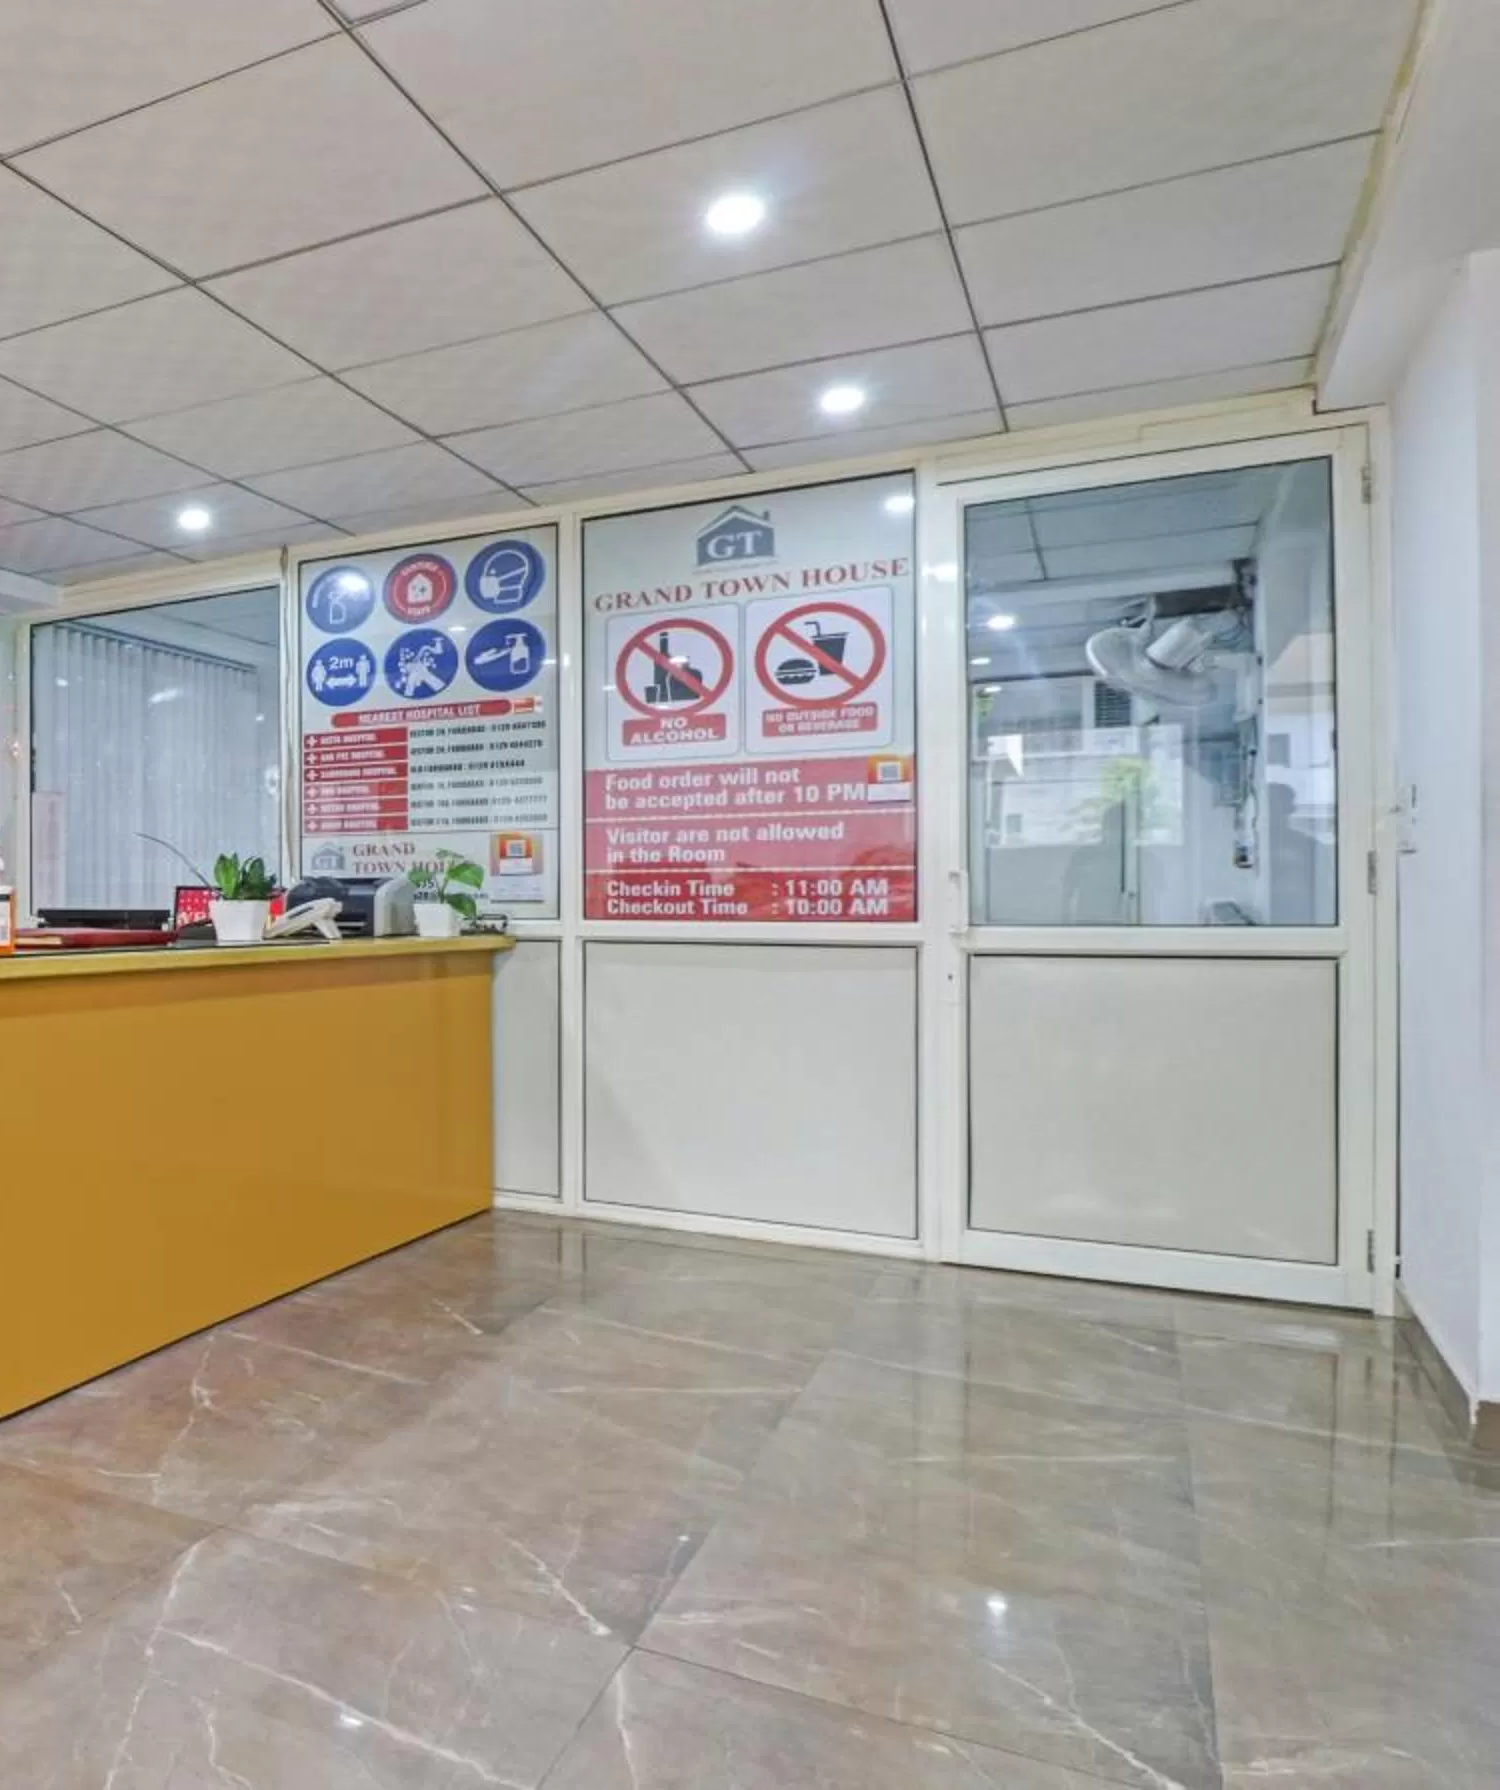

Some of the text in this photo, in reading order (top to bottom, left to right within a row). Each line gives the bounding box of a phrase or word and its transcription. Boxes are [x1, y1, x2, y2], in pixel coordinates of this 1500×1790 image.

[706, 530, 764, 560] GT
[594, 556, 911, 613] GRAND TOWN HOUSE
[329, 656, 355, 669] 2m
[840, 706, 875, 719] FOOD
[660, 716, 689, 729] NO
[630, 728, 720, 745] ALCOHOL
[605, 767, 800, 791] Food order will not
[605, 783, 868, 812] be accepted after 10 PM
[606, 821, 846, 845] Visitor are not allowed
[352, 842, 417, 857] GRAND
[606, 845, 726, 864] in the Room
[352, 861, 406, 875] TOWN
[606, 879, 682, 897] Checkin
[687, 879, 735, 897] Time
[785, 879, 843, 896] 11:00
[849, 878, 889, 896] AM
[606, 898, 695, 916] Checkout
[701, 898, 749, 915] Time
[785, 898, 843, 915] 10:00
[848, 898, 889, 915] AM
